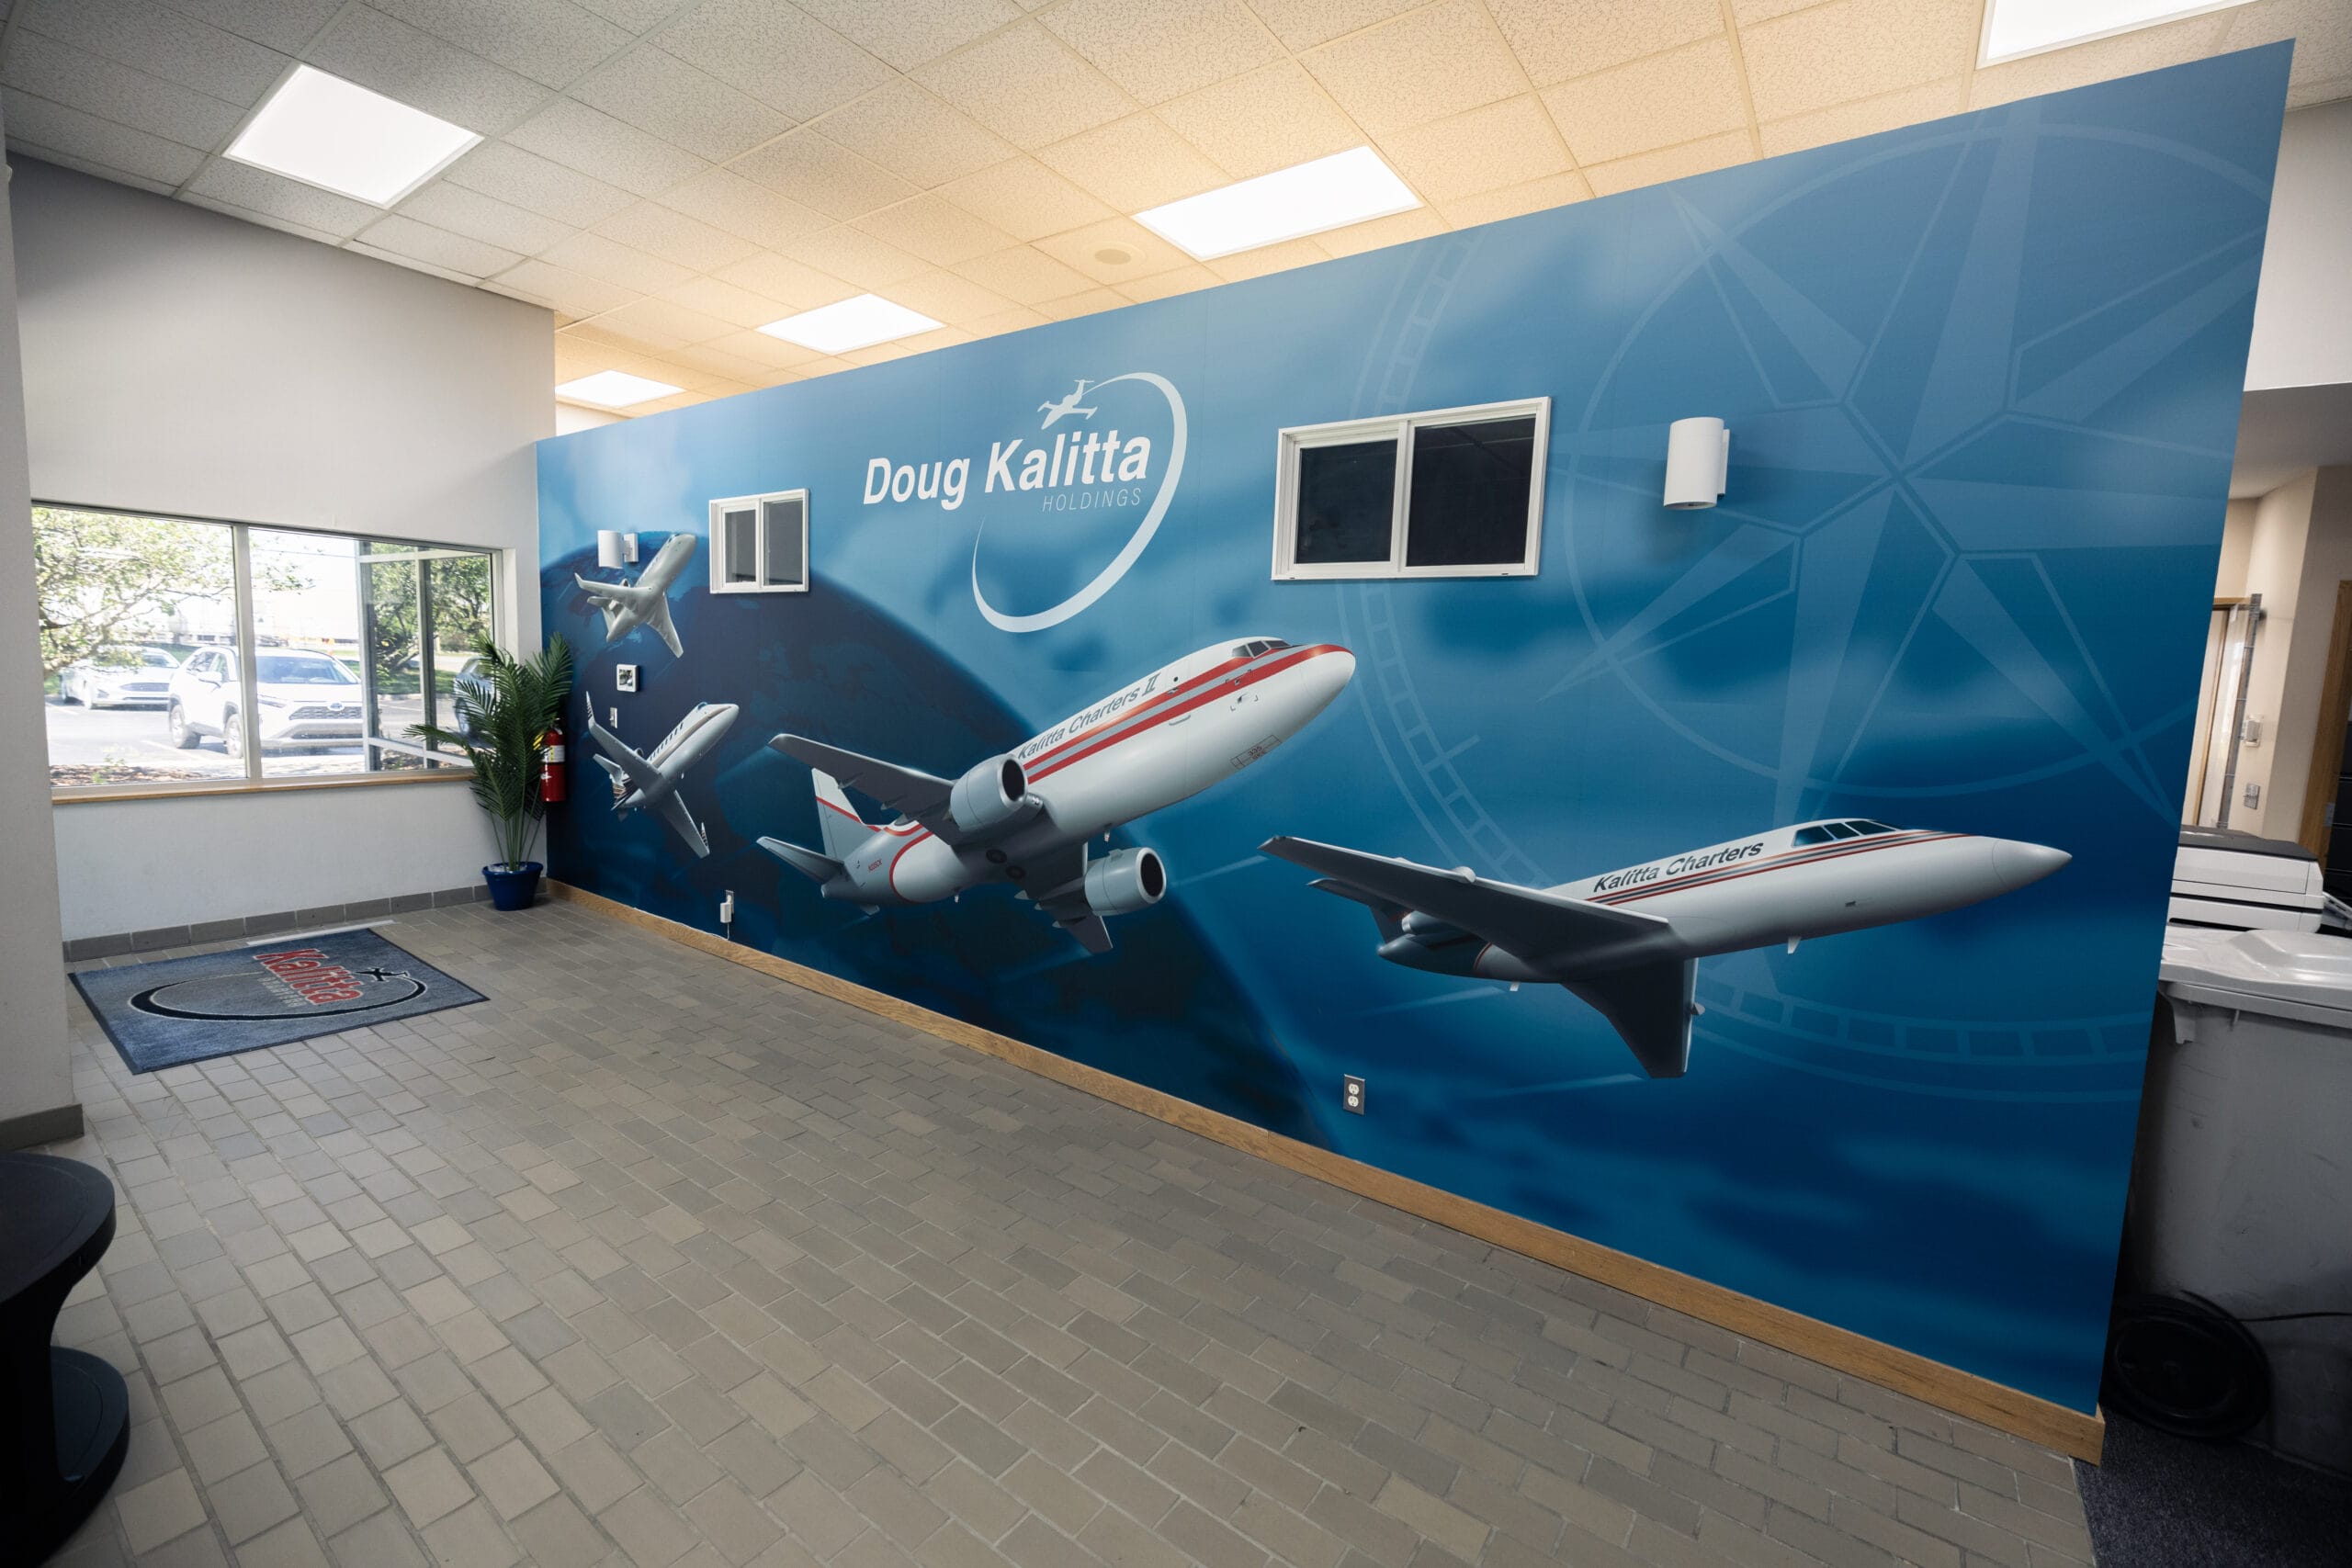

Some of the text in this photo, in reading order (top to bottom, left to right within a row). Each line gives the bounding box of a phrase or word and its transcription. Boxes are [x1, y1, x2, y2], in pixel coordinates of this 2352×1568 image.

[864, 430, 1151, 511] Doug Kalitta
[1042, 488, 1142, 513] HOLDINGS
[1018, 672, 1161, 760] Kalitta Charters II
[1593, 842, 1764, 893] Kalitta Charters
[252, 948, 364, 1006] Kalitta
